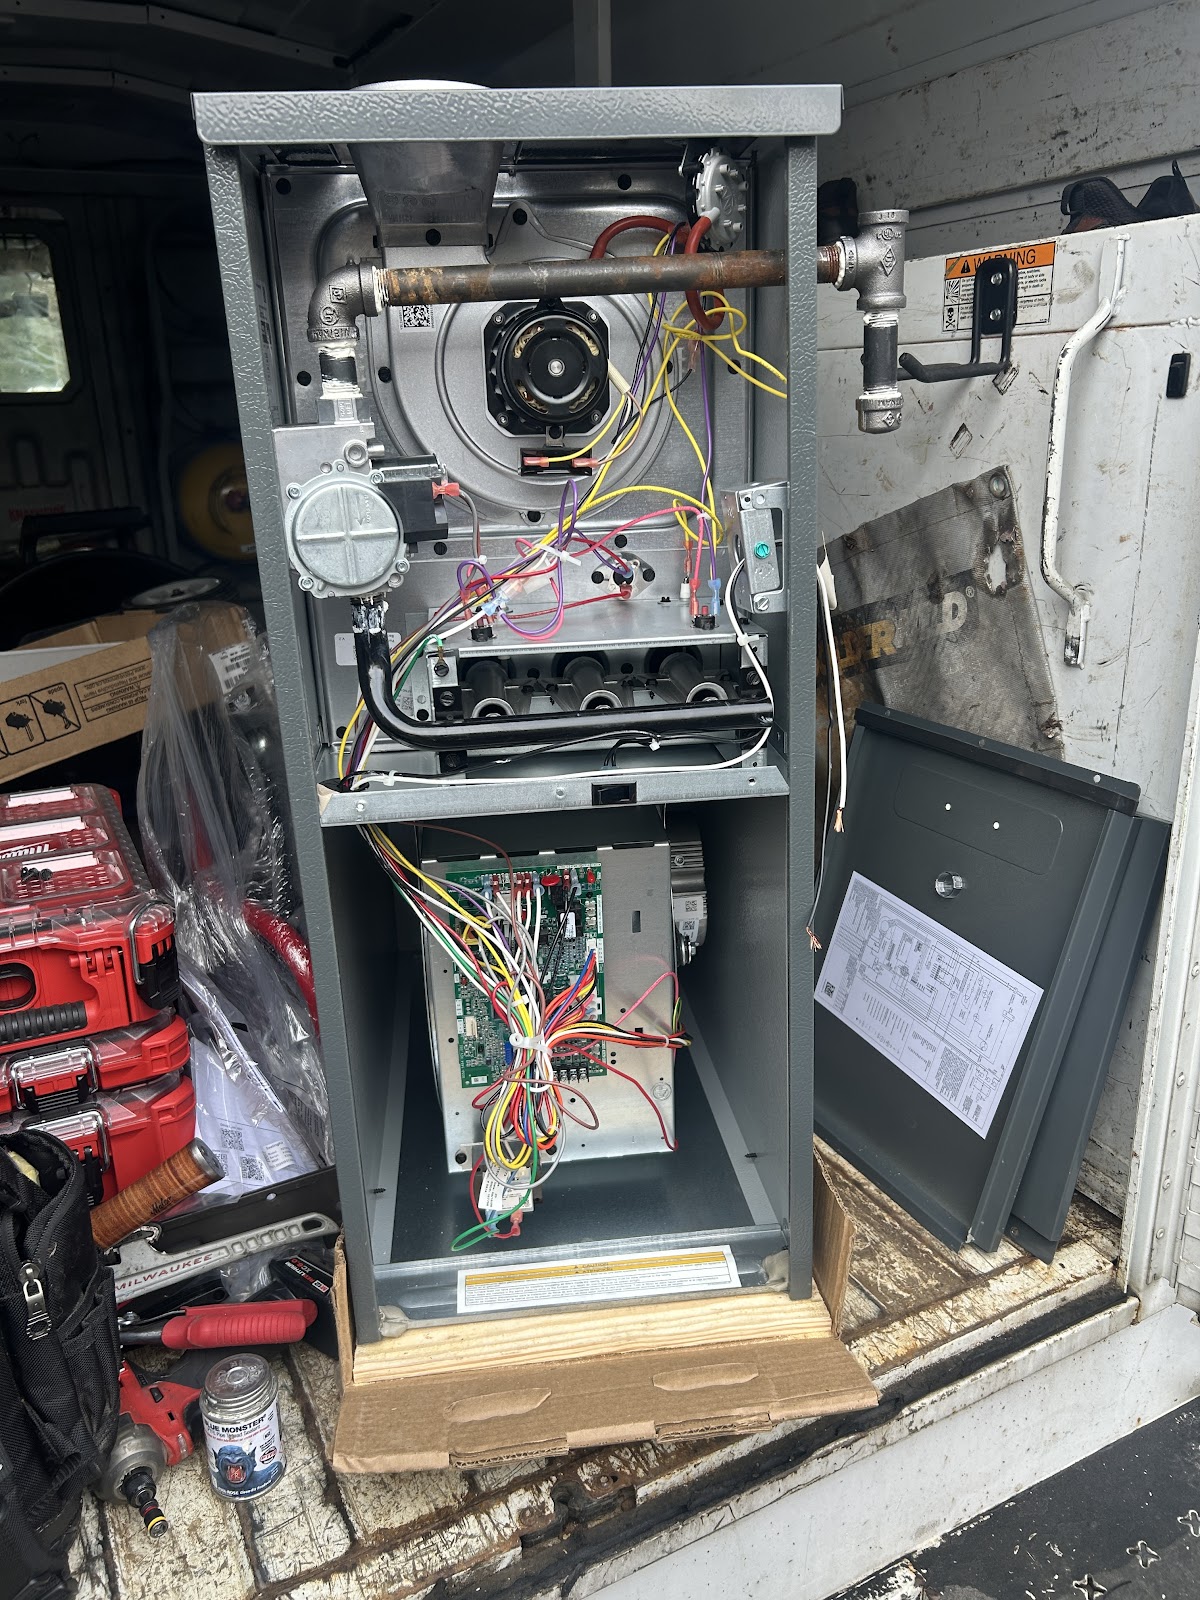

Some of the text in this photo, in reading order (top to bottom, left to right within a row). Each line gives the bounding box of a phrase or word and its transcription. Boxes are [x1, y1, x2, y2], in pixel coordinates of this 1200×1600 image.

[47, 685, 63, 695] spade
[109, 684, 134, 697] WARNING
[15, 697, 27, 706] fork
[115, 1253, 213, 1290] MILWAUKEE
